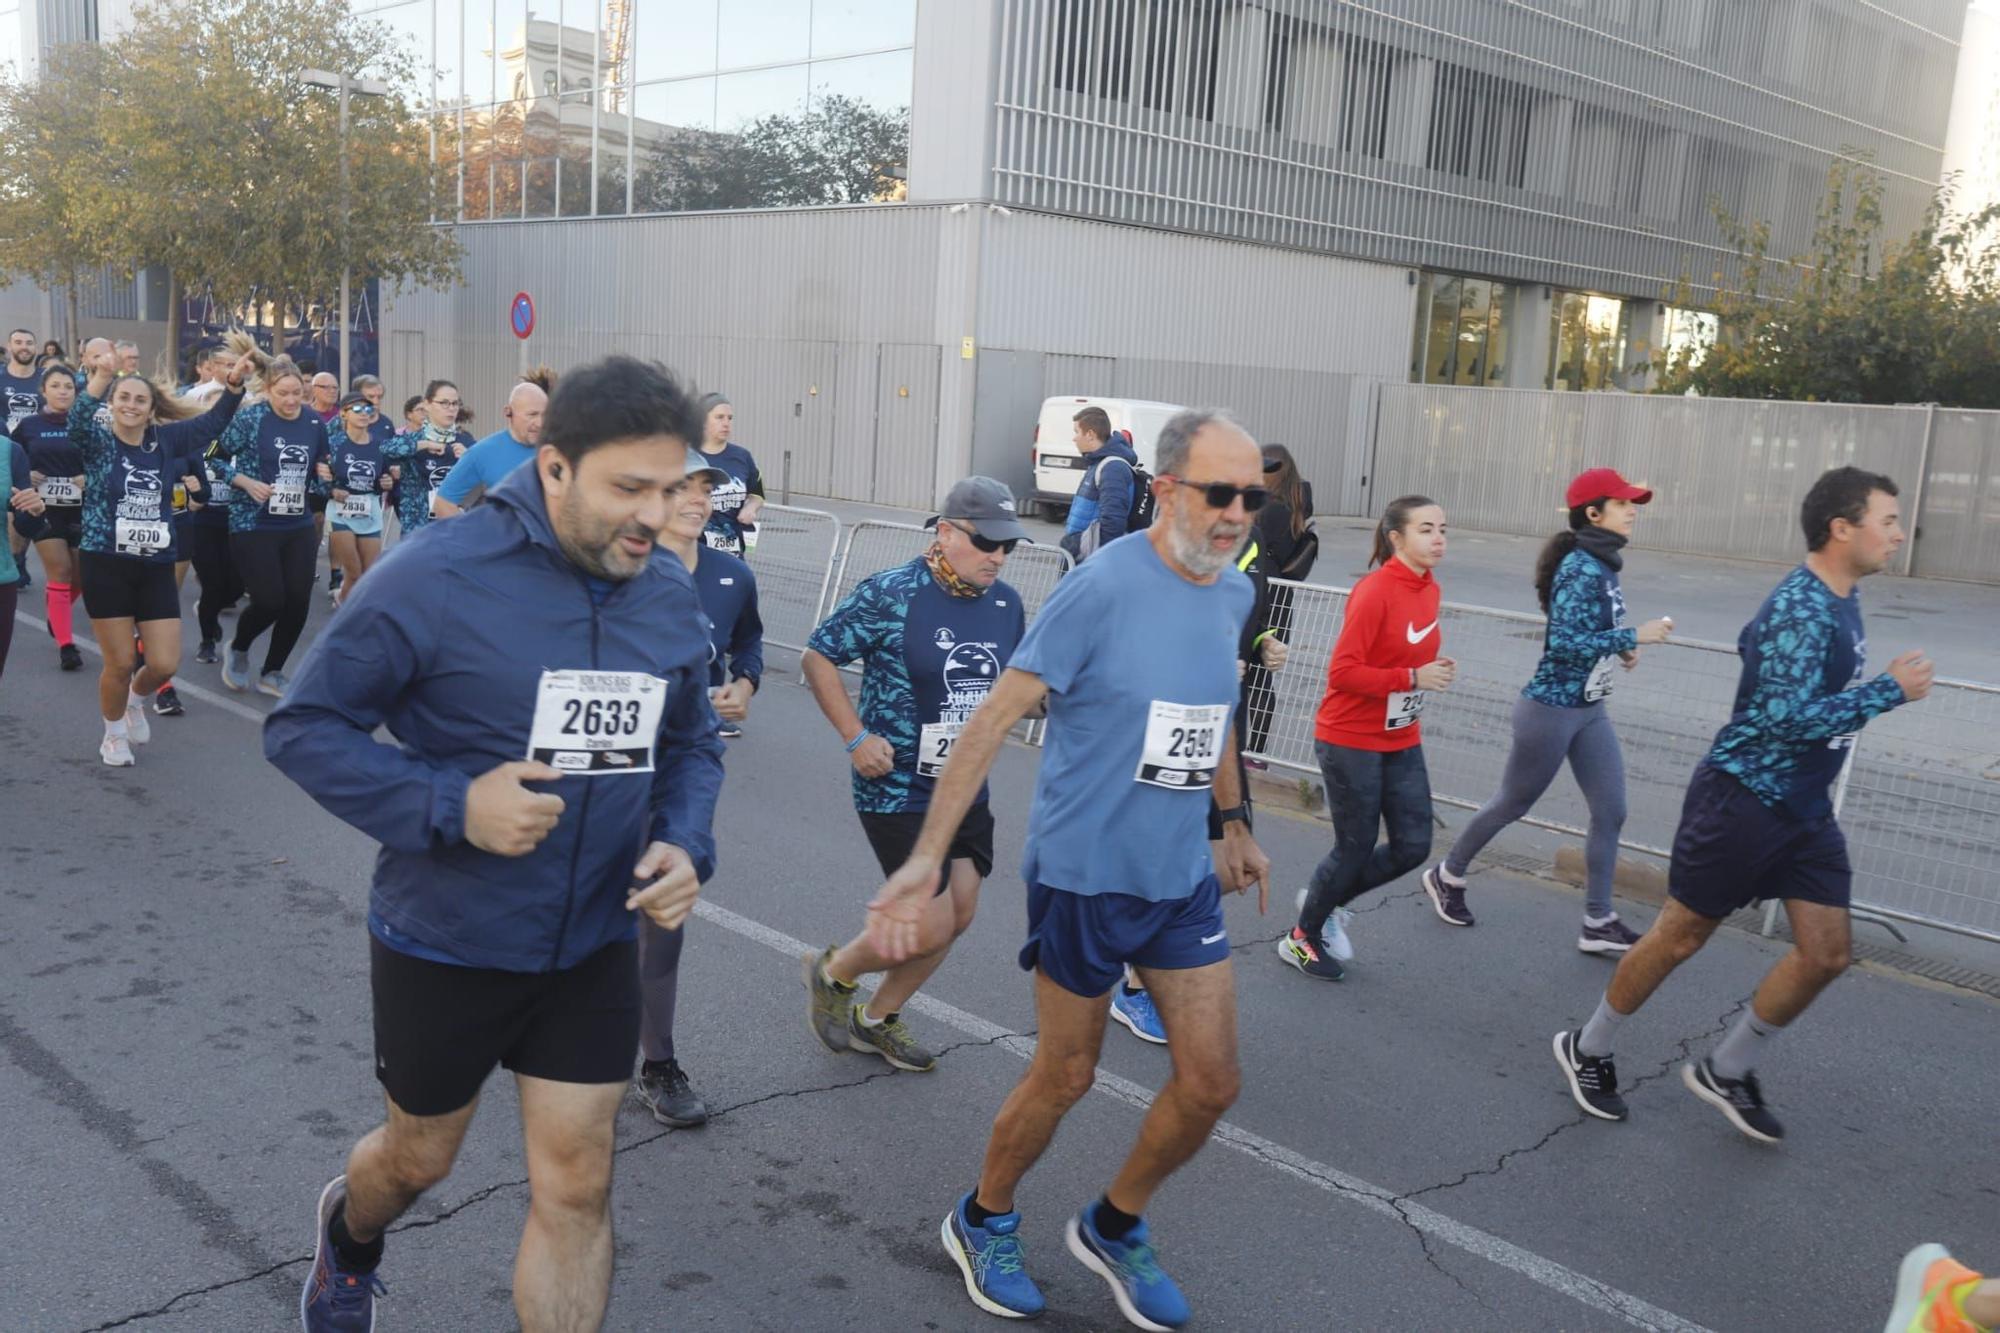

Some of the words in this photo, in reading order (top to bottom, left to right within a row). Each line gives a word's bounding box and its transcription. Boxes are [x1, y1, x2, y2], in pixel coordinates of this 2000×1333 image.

[47, 484, 72, 496] 2775
[128, 528, 160, 543] 2670
[561, 699, 641, 735] 2633
